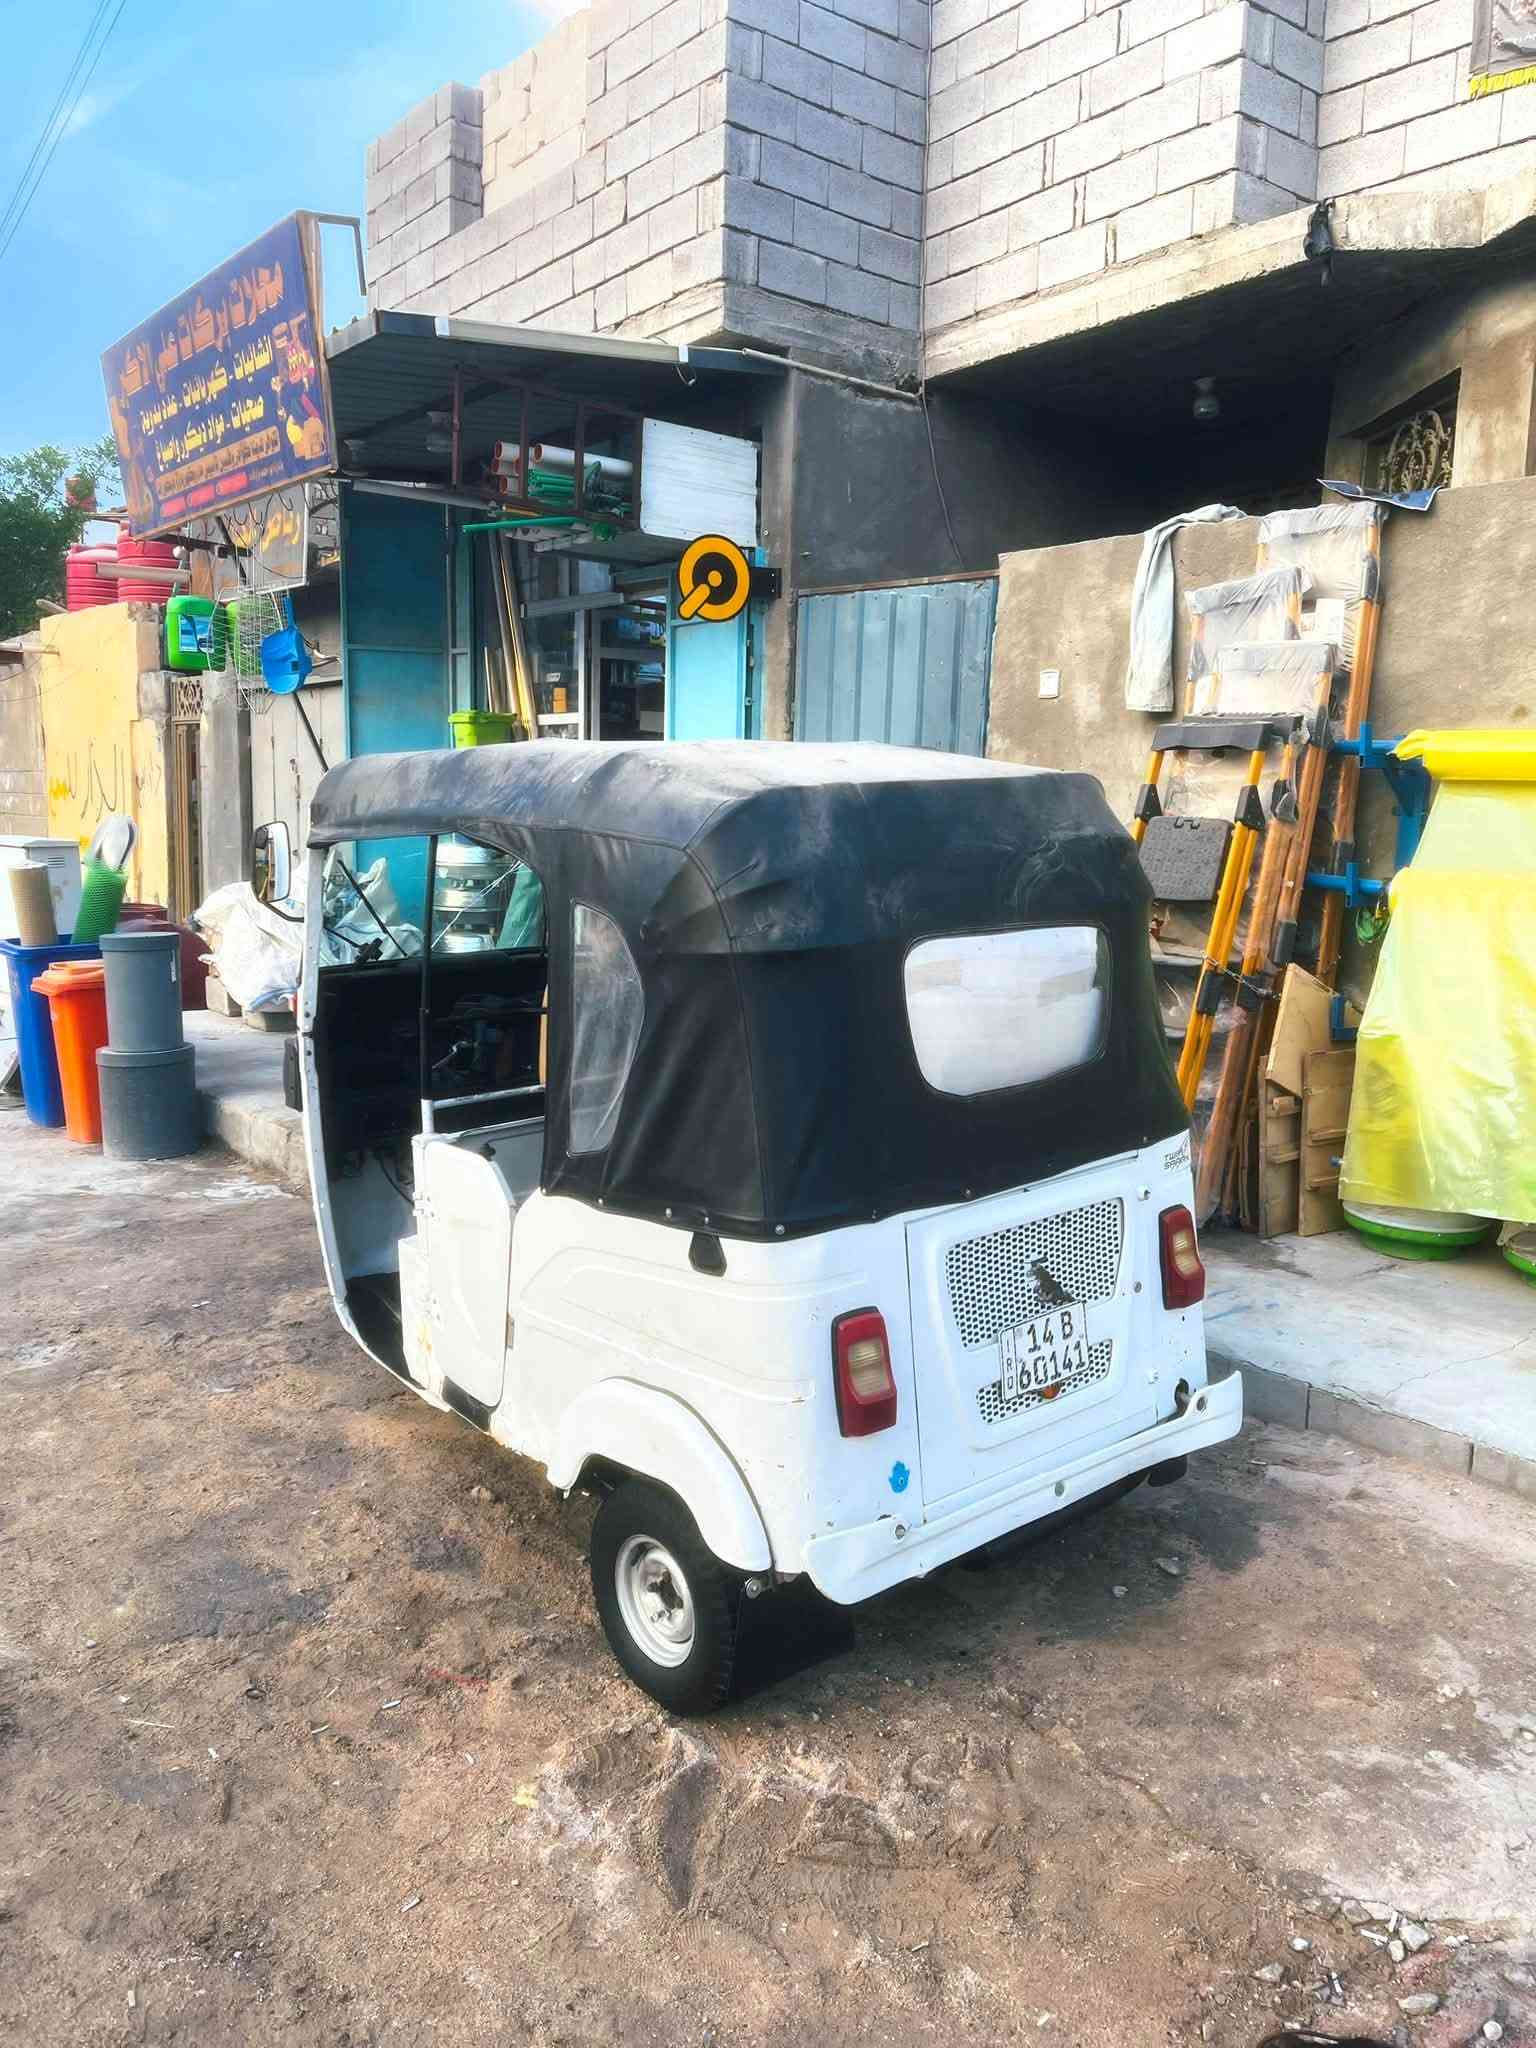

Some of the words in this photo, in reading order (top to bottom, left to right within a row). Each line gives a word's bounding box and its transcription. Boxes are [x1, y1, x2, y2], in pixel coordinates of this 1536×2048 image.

[229, 260, 285, 330] محلات
[1027, 1317, 1054, 1353] 14
[1060, 1311, 1073, 1340] B
[1019, 1340, 1086, 1391] 60141
